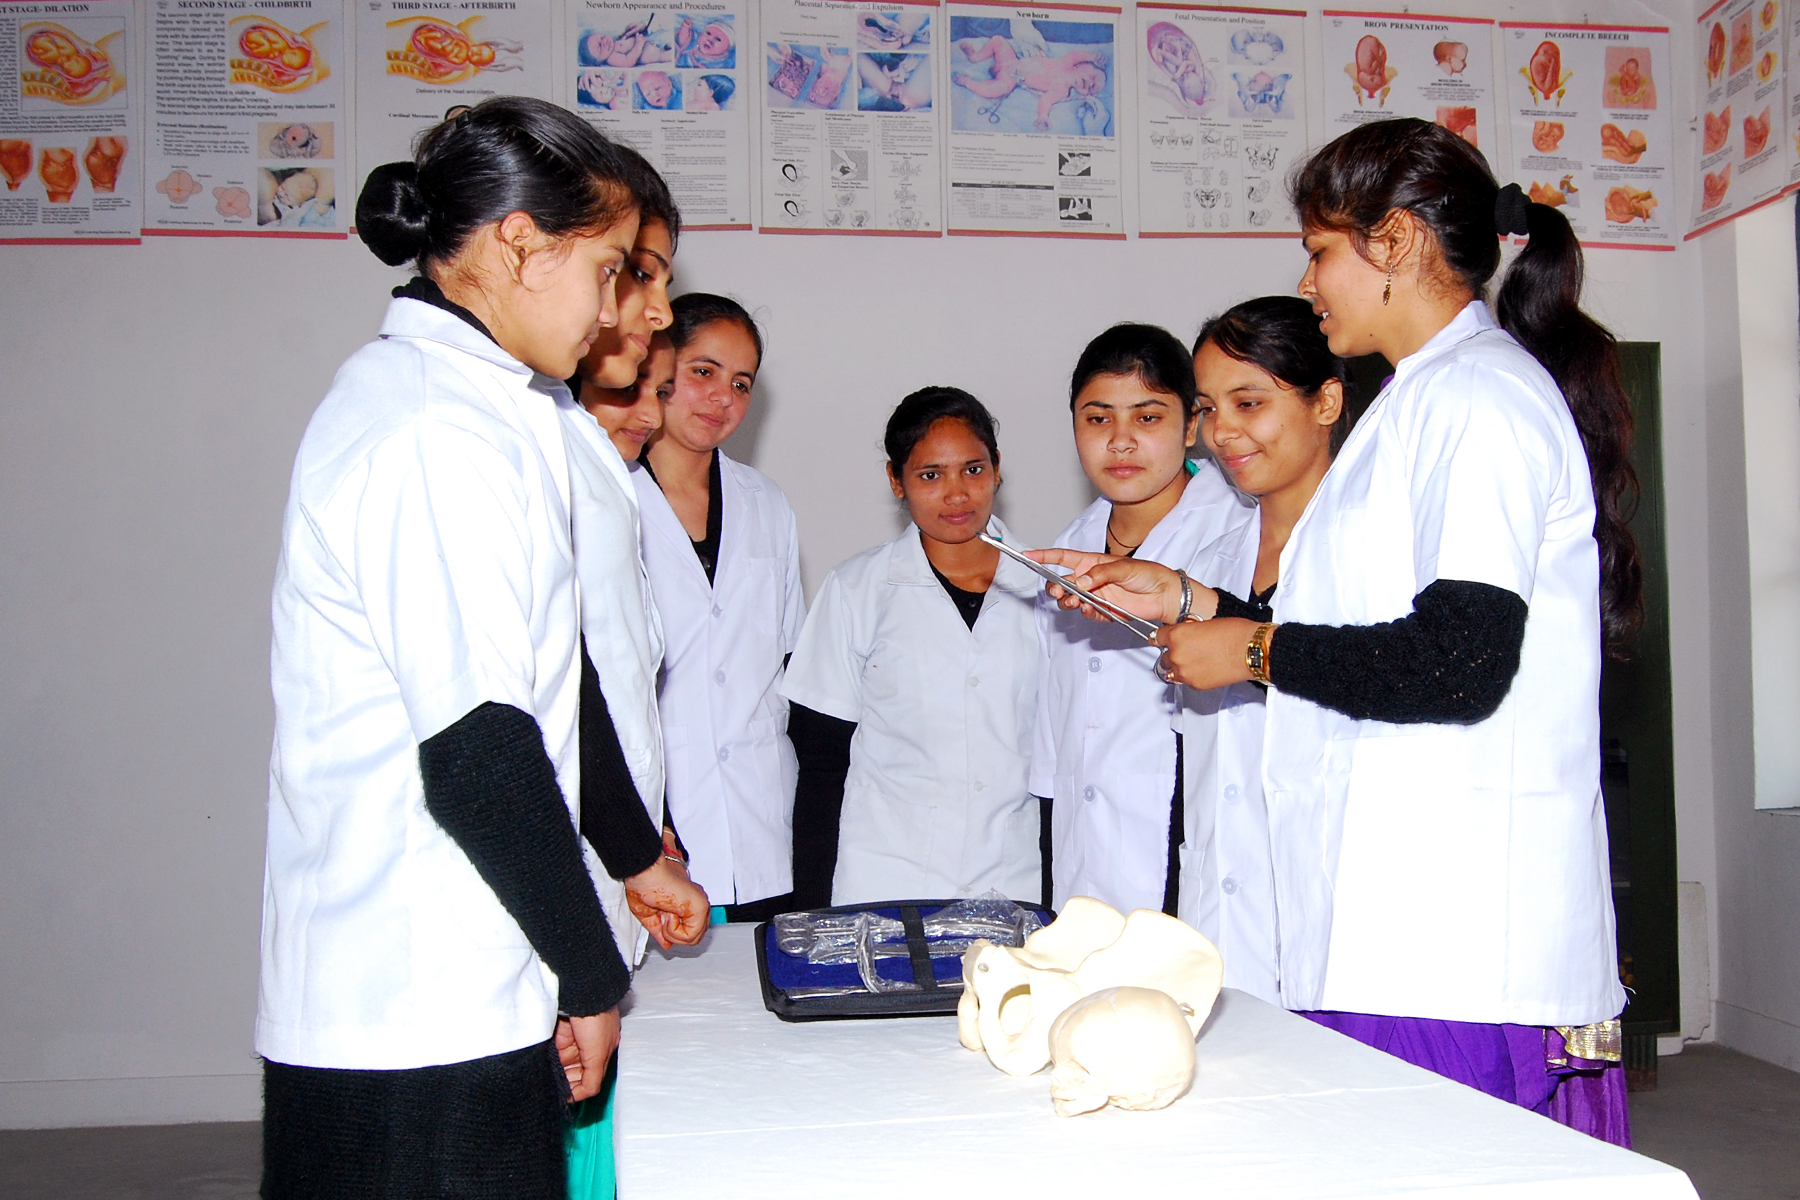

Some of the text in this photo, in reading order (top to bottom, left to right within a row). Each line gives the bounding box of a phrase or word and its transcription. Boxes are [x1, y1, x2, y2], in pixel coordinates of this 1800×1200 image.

[45, 4, 90, 12] DILATION
[622, 2, 666, 10] Appearance
[872, 3, 904, 11] Expulsion
[1016, 10, 1050, 19] Newborn
[1191, 14, 1227, 22] Presentation
[1241, 16, 1266, 25] Position
[1390, 22, 1449, 32] PRESENTATION
[1544, 31, 1596, 40] INCOMPLETE
